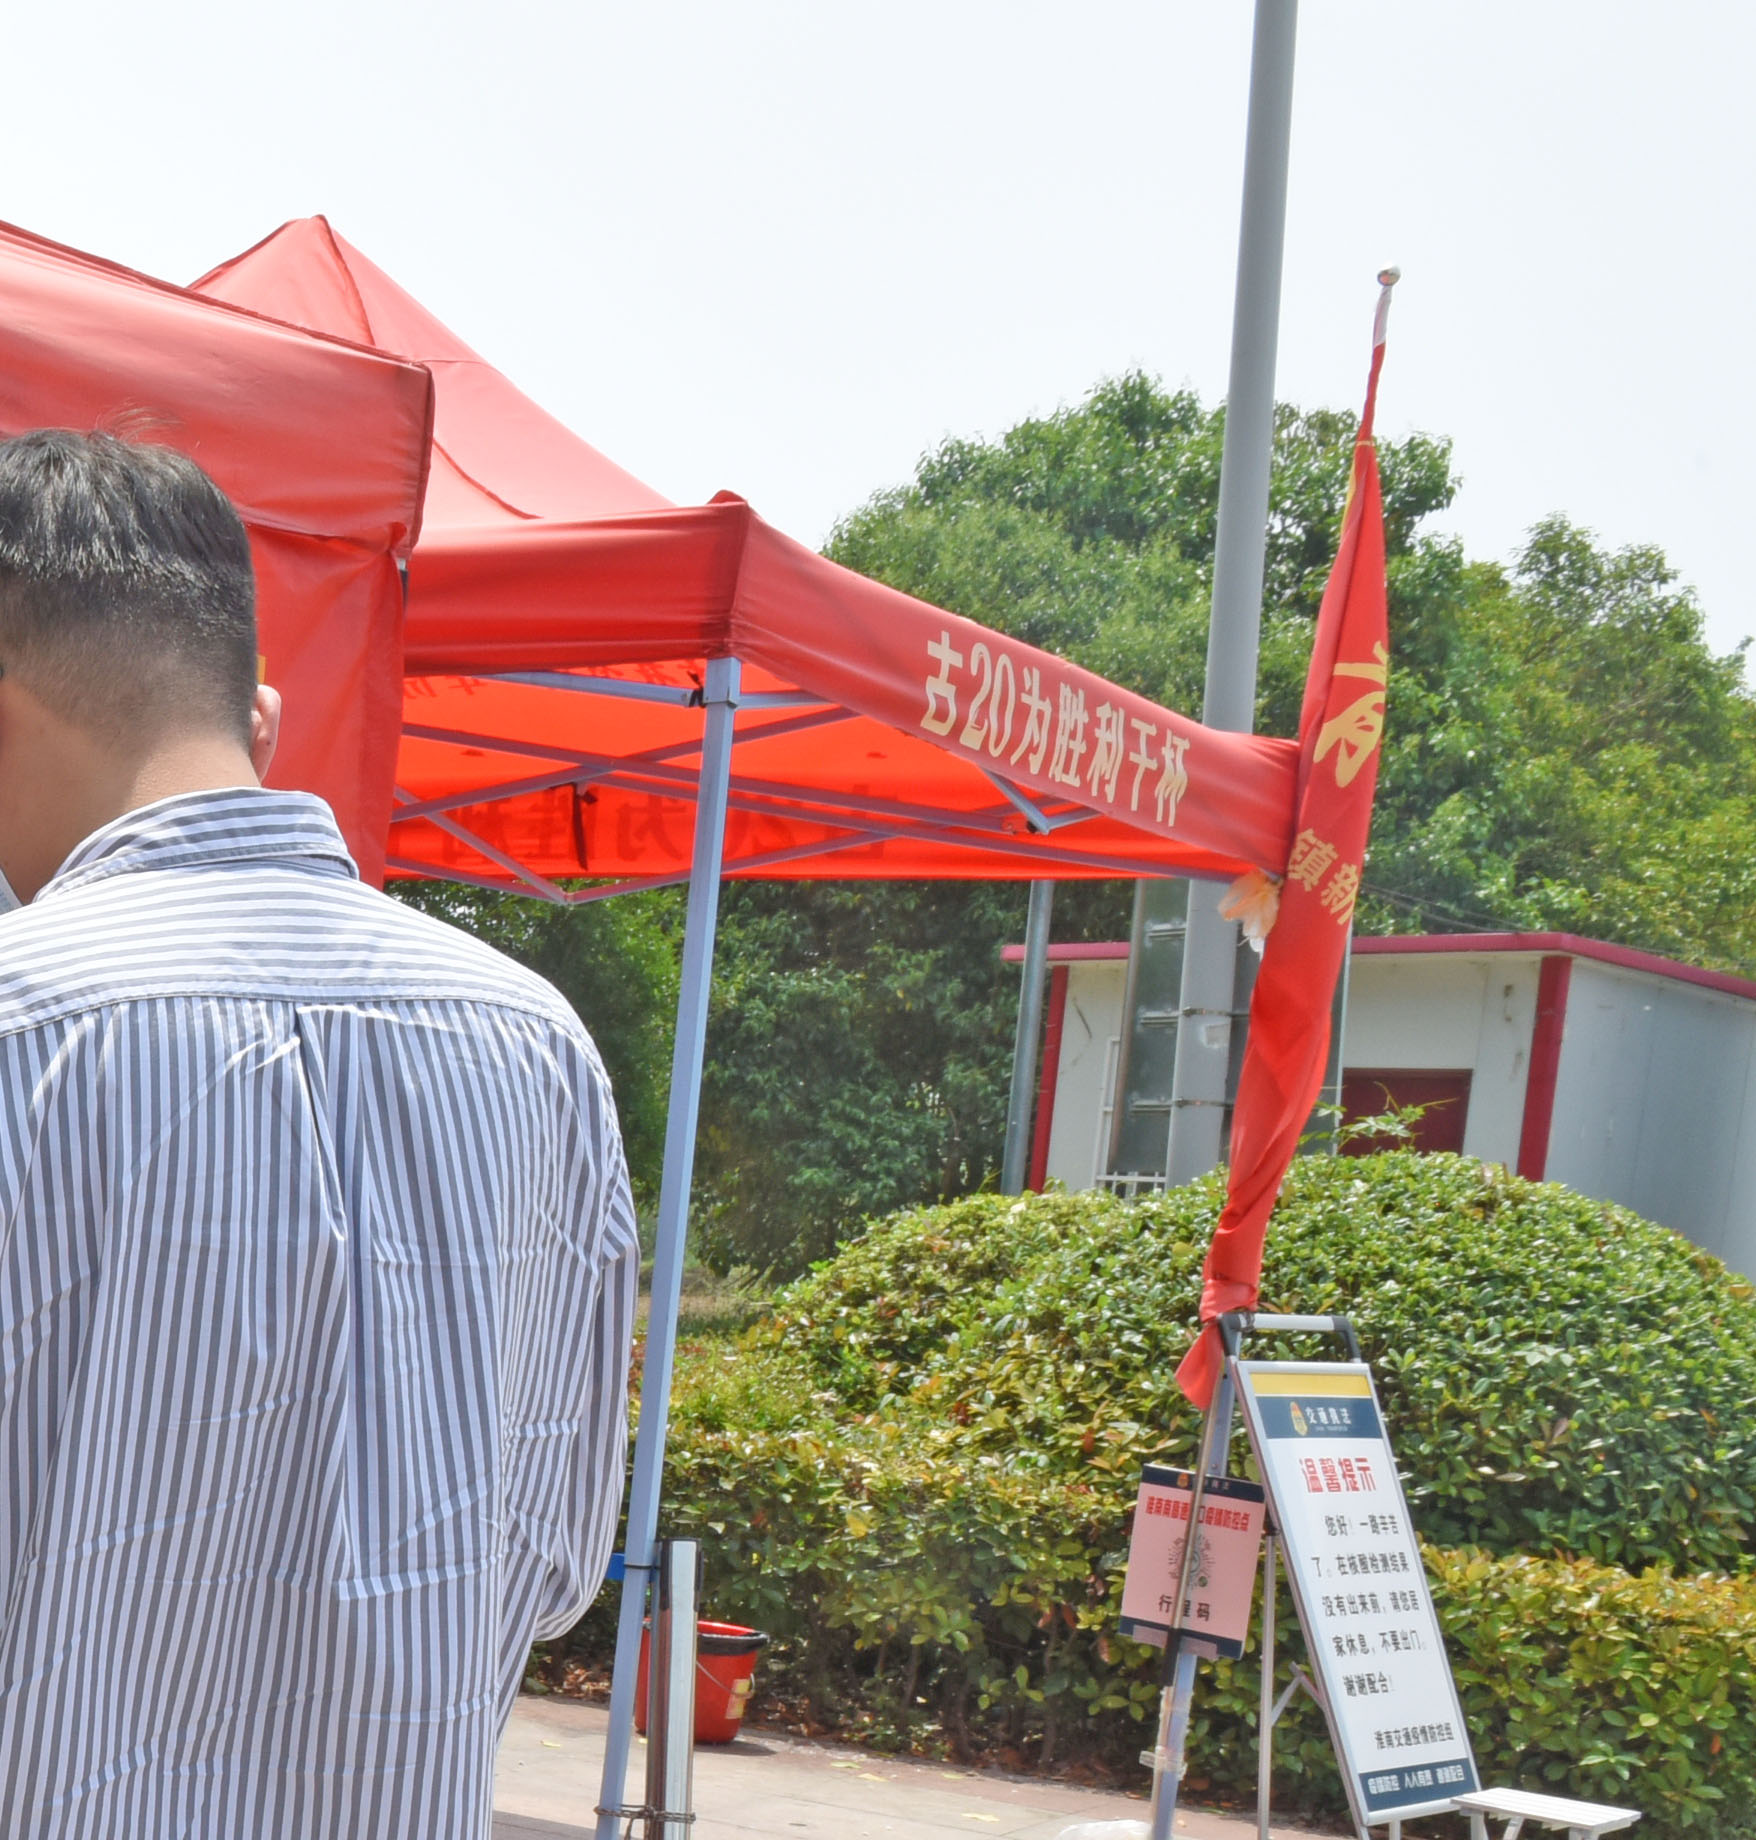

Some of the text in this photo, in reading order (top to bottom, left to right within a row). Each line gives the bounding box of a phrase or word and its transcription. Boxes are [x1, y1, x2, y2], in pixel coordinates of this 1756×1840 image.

[924, 628, 1191, 829] 古20为胜利干杯
[1299, 1457, 1377, 1493] 温馨提示
[1146, 1496, 1250, 1531] 淮南南高速口疫情防控点
